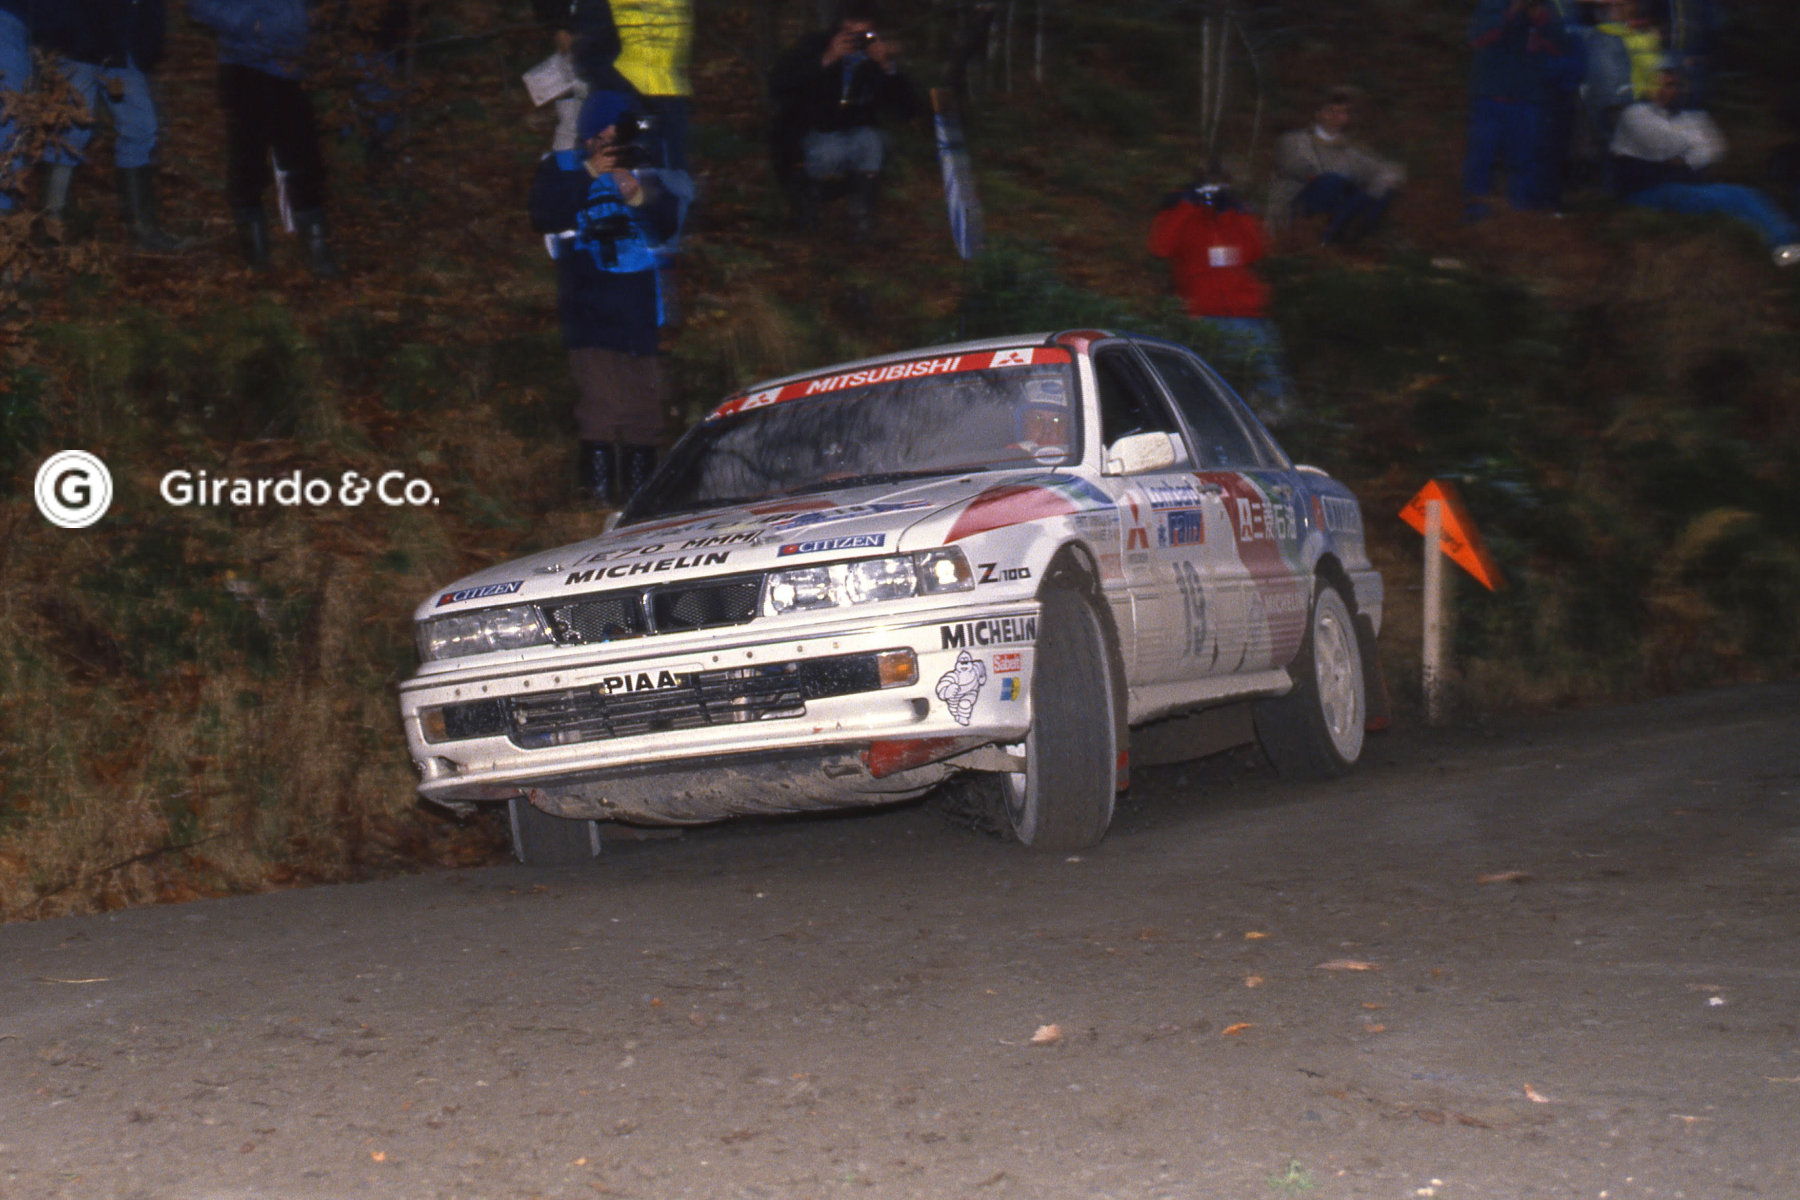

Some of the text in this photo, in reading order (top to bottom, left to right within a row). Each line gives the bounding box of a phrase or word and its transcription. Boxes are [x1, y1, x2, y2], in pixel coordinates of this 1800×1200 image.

[805, 356, 962, 395] MITSUBISHI
[588, 531, 750, 564] E70 MMM
[797, 534, 884, 554] CITIZEN
[564, 551, 731, 586] MICHELIN
[451, 581, 522, 603] CITIZEN
[940, 616, 1037, 650] MICHELIN
[603, 670, 678, 694] PIAA
